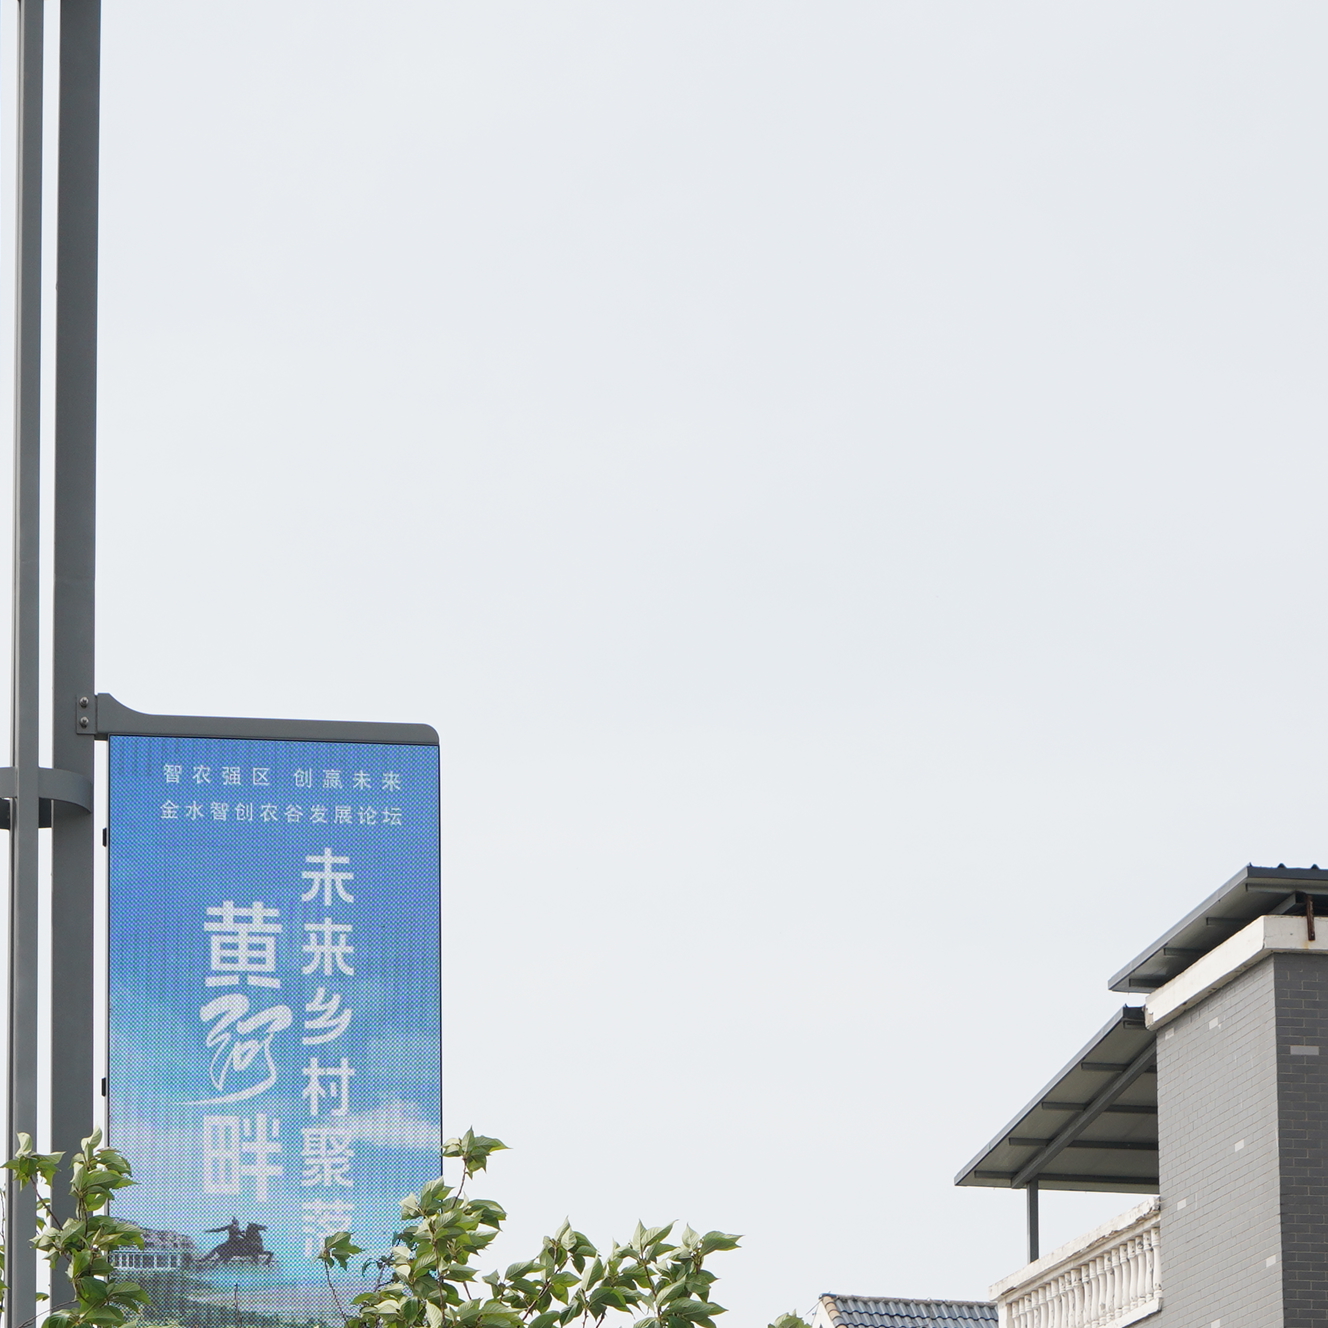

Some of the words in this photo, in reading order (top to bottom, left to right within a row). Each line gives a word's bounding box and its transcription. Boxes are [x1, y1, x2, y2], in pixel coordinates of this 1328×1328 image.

[163, 763, 270, 787] 智农强区
[293, 767, 401, 791] 创赢未来
[160, 800, 402, 826] 金水智创农谷发展论坛
[186, 901, 293, 1201] 黄河畔
